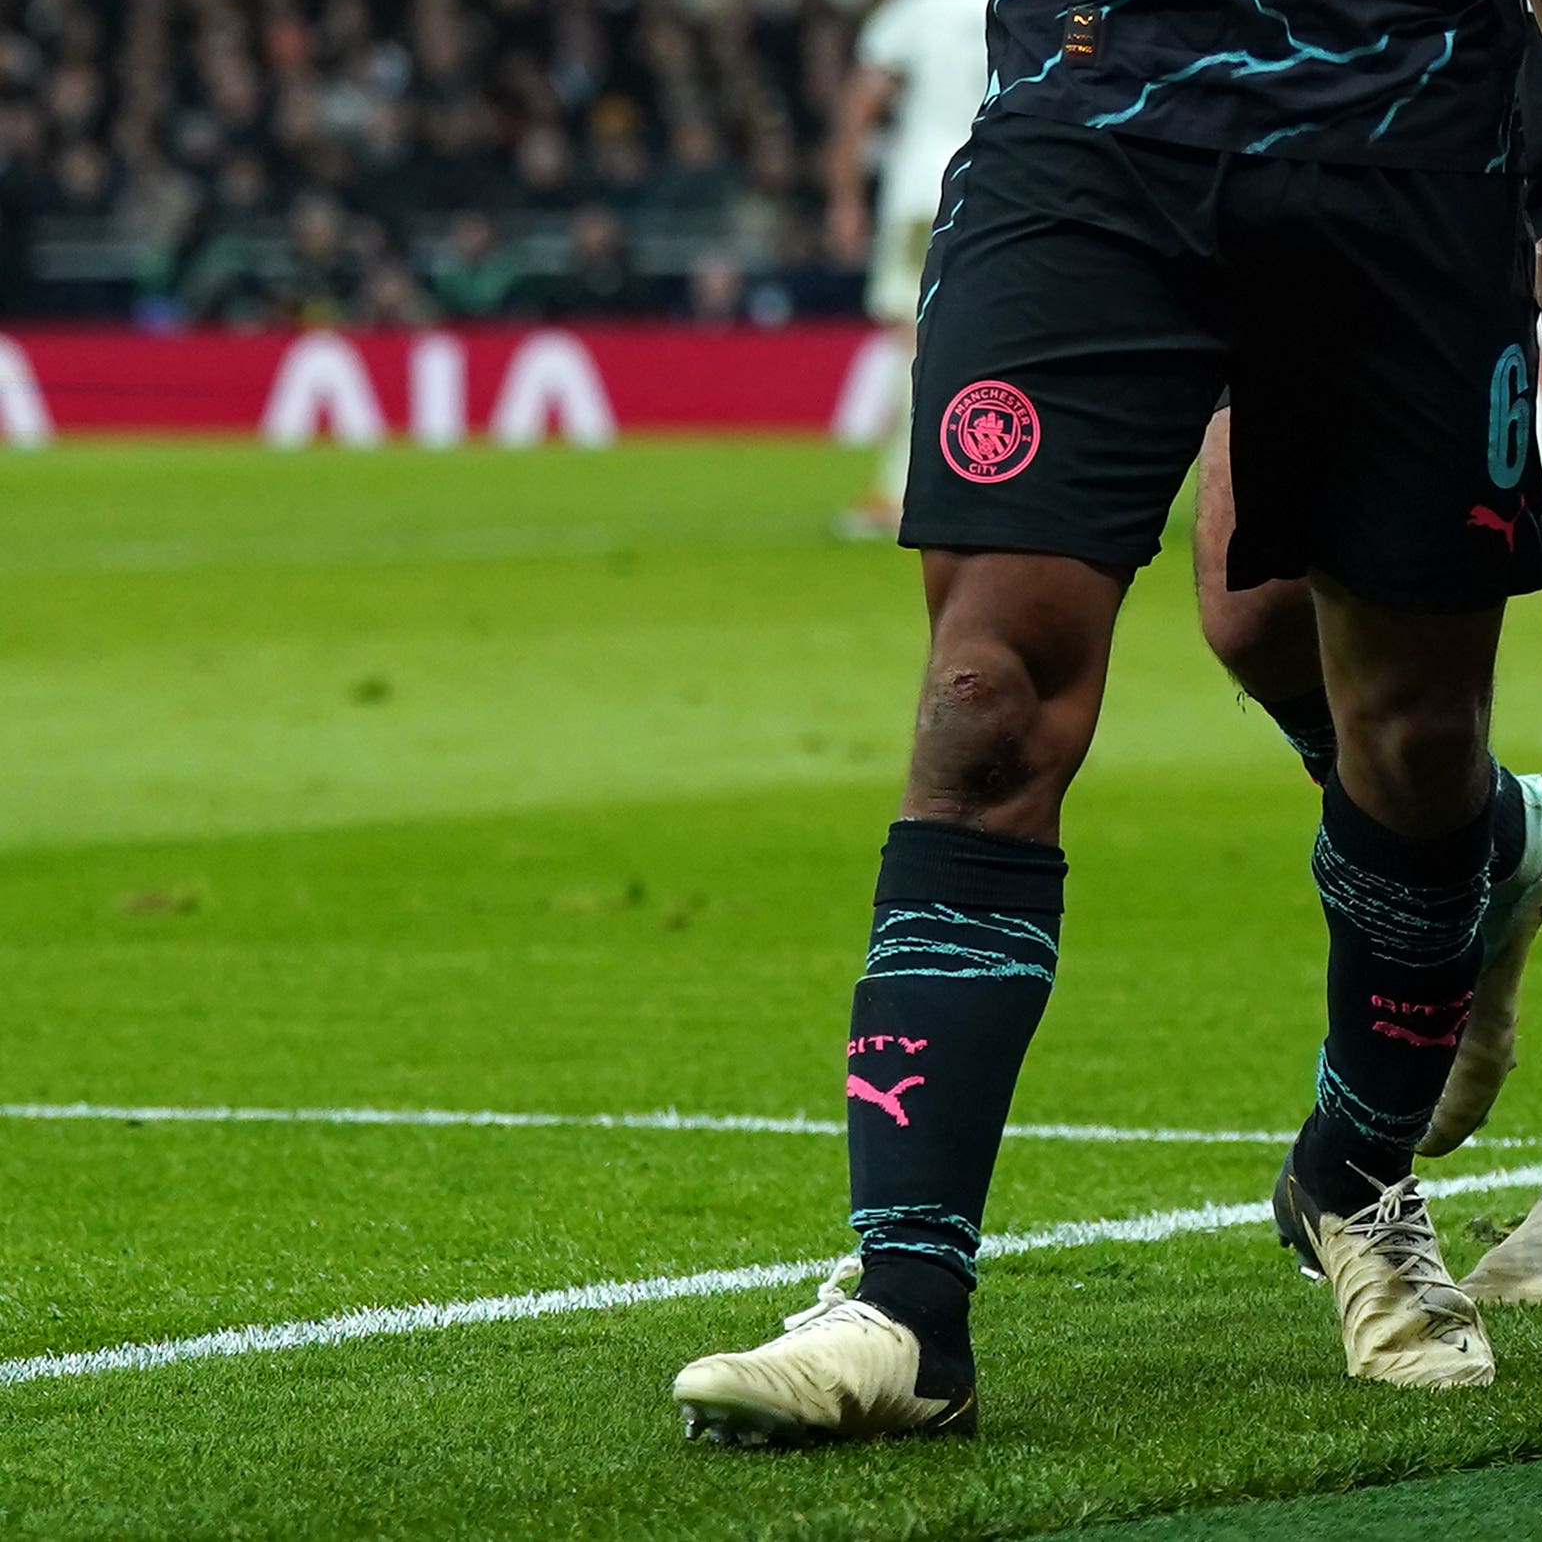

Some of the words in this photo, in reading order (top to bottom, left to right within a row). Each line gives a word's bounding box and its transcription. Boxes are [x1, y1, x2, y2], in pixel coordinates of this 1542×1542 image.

[257, 328, 620, 450] AIA
[955, 389, 1031, 426] MANCHESTER
[1487, 343, 1528, 489] 6
[968, 463, 998, 475] CITY
[847, 1034, 928, 1058] CITY
